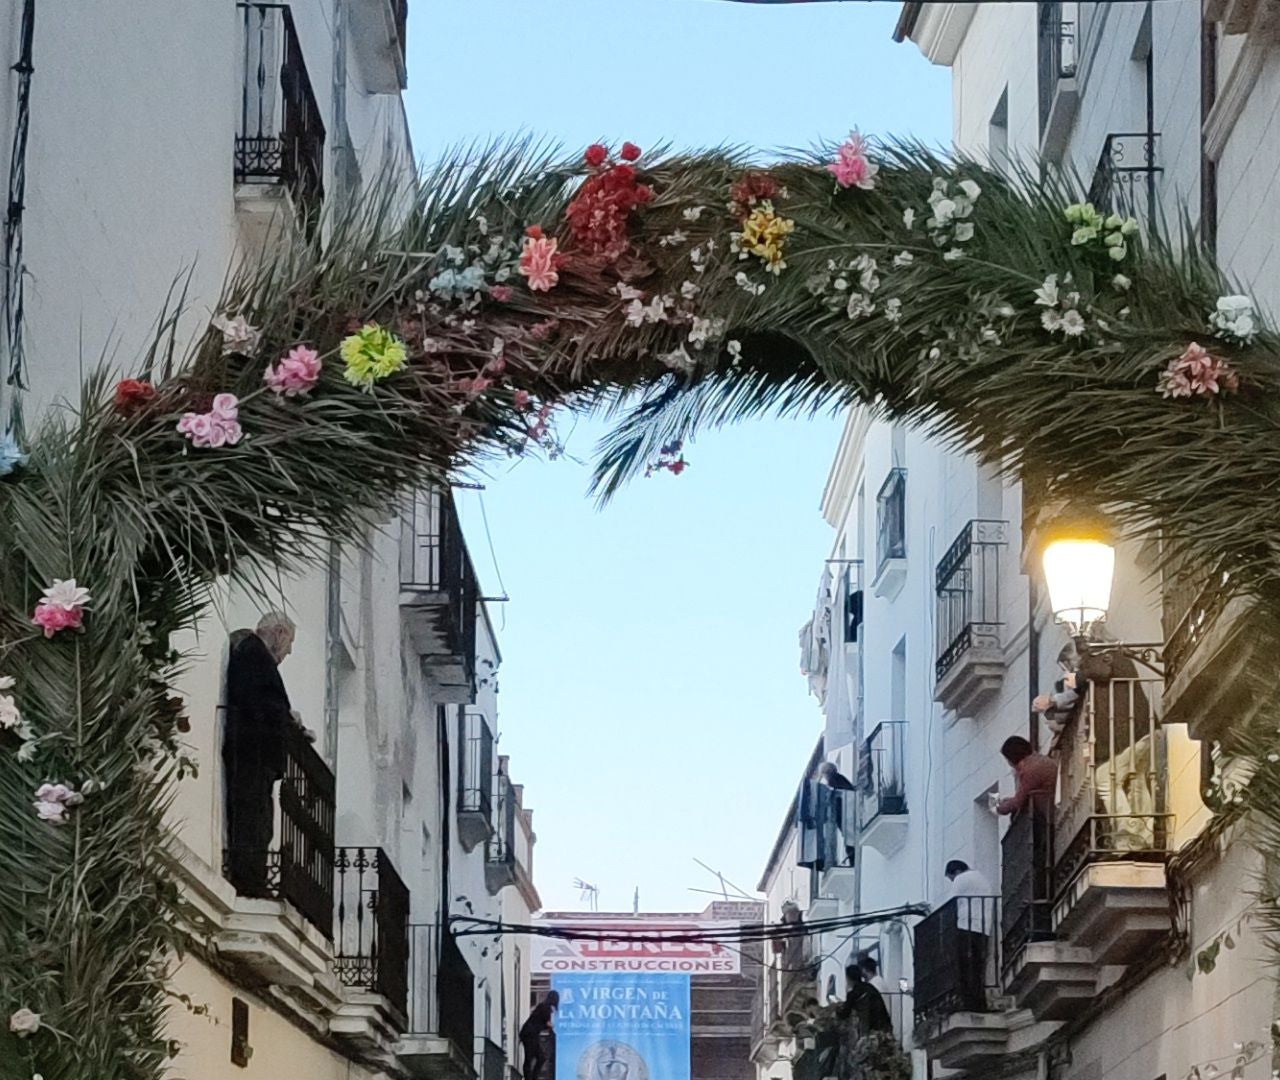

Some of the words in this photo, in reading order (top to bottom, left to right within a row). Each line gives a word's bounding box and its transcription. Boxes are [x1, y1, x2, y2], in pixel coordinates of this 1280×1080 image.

[540, 960, 734, 971] CONSTRUCCIONES
[580, 987, 647, 1000] VIRGEN
[652, 991, 669, 1000] DE
[559, 1010, 574, 1019] LA
[578, 1002, 682, 1019] MONTAÑA
